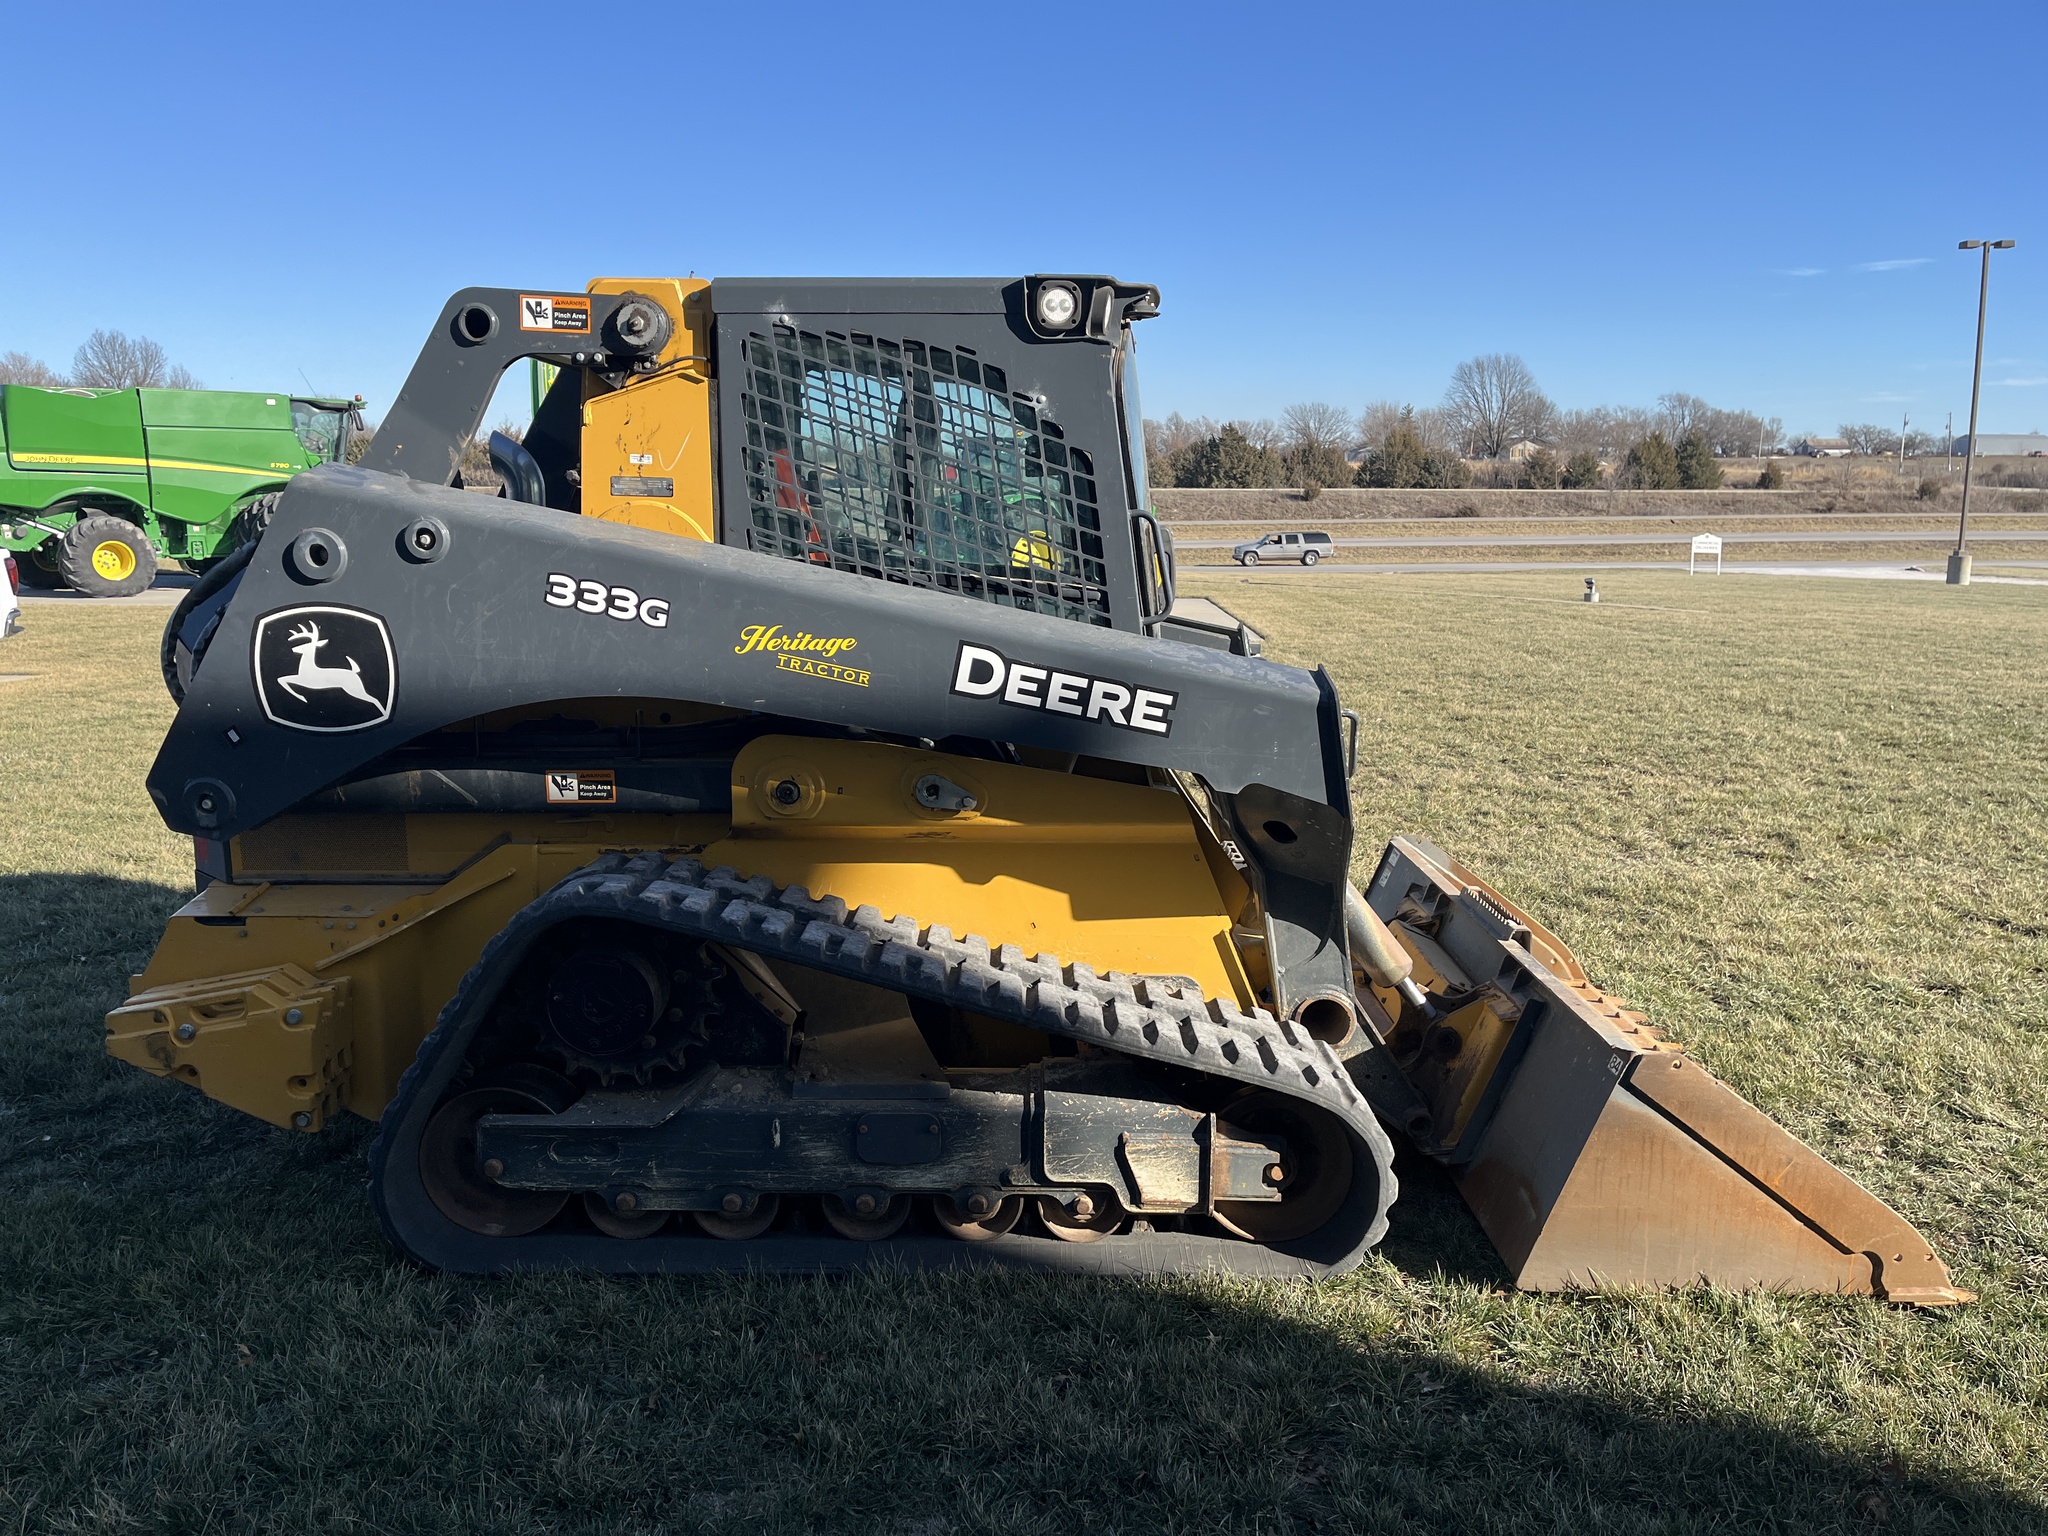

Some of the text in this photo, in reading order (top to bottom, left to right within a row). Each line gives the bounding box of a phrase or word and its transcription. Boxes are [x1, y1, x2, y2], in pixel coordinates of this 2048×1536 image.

[545, 573, 670, 628] 333G
[734, 624, 858, 657] Heritage
[777, 654, 870, 686] TRACTOR
[954, 644, 1174, 733] DEERE
[1610, 1056, 1622, 1073] 84
